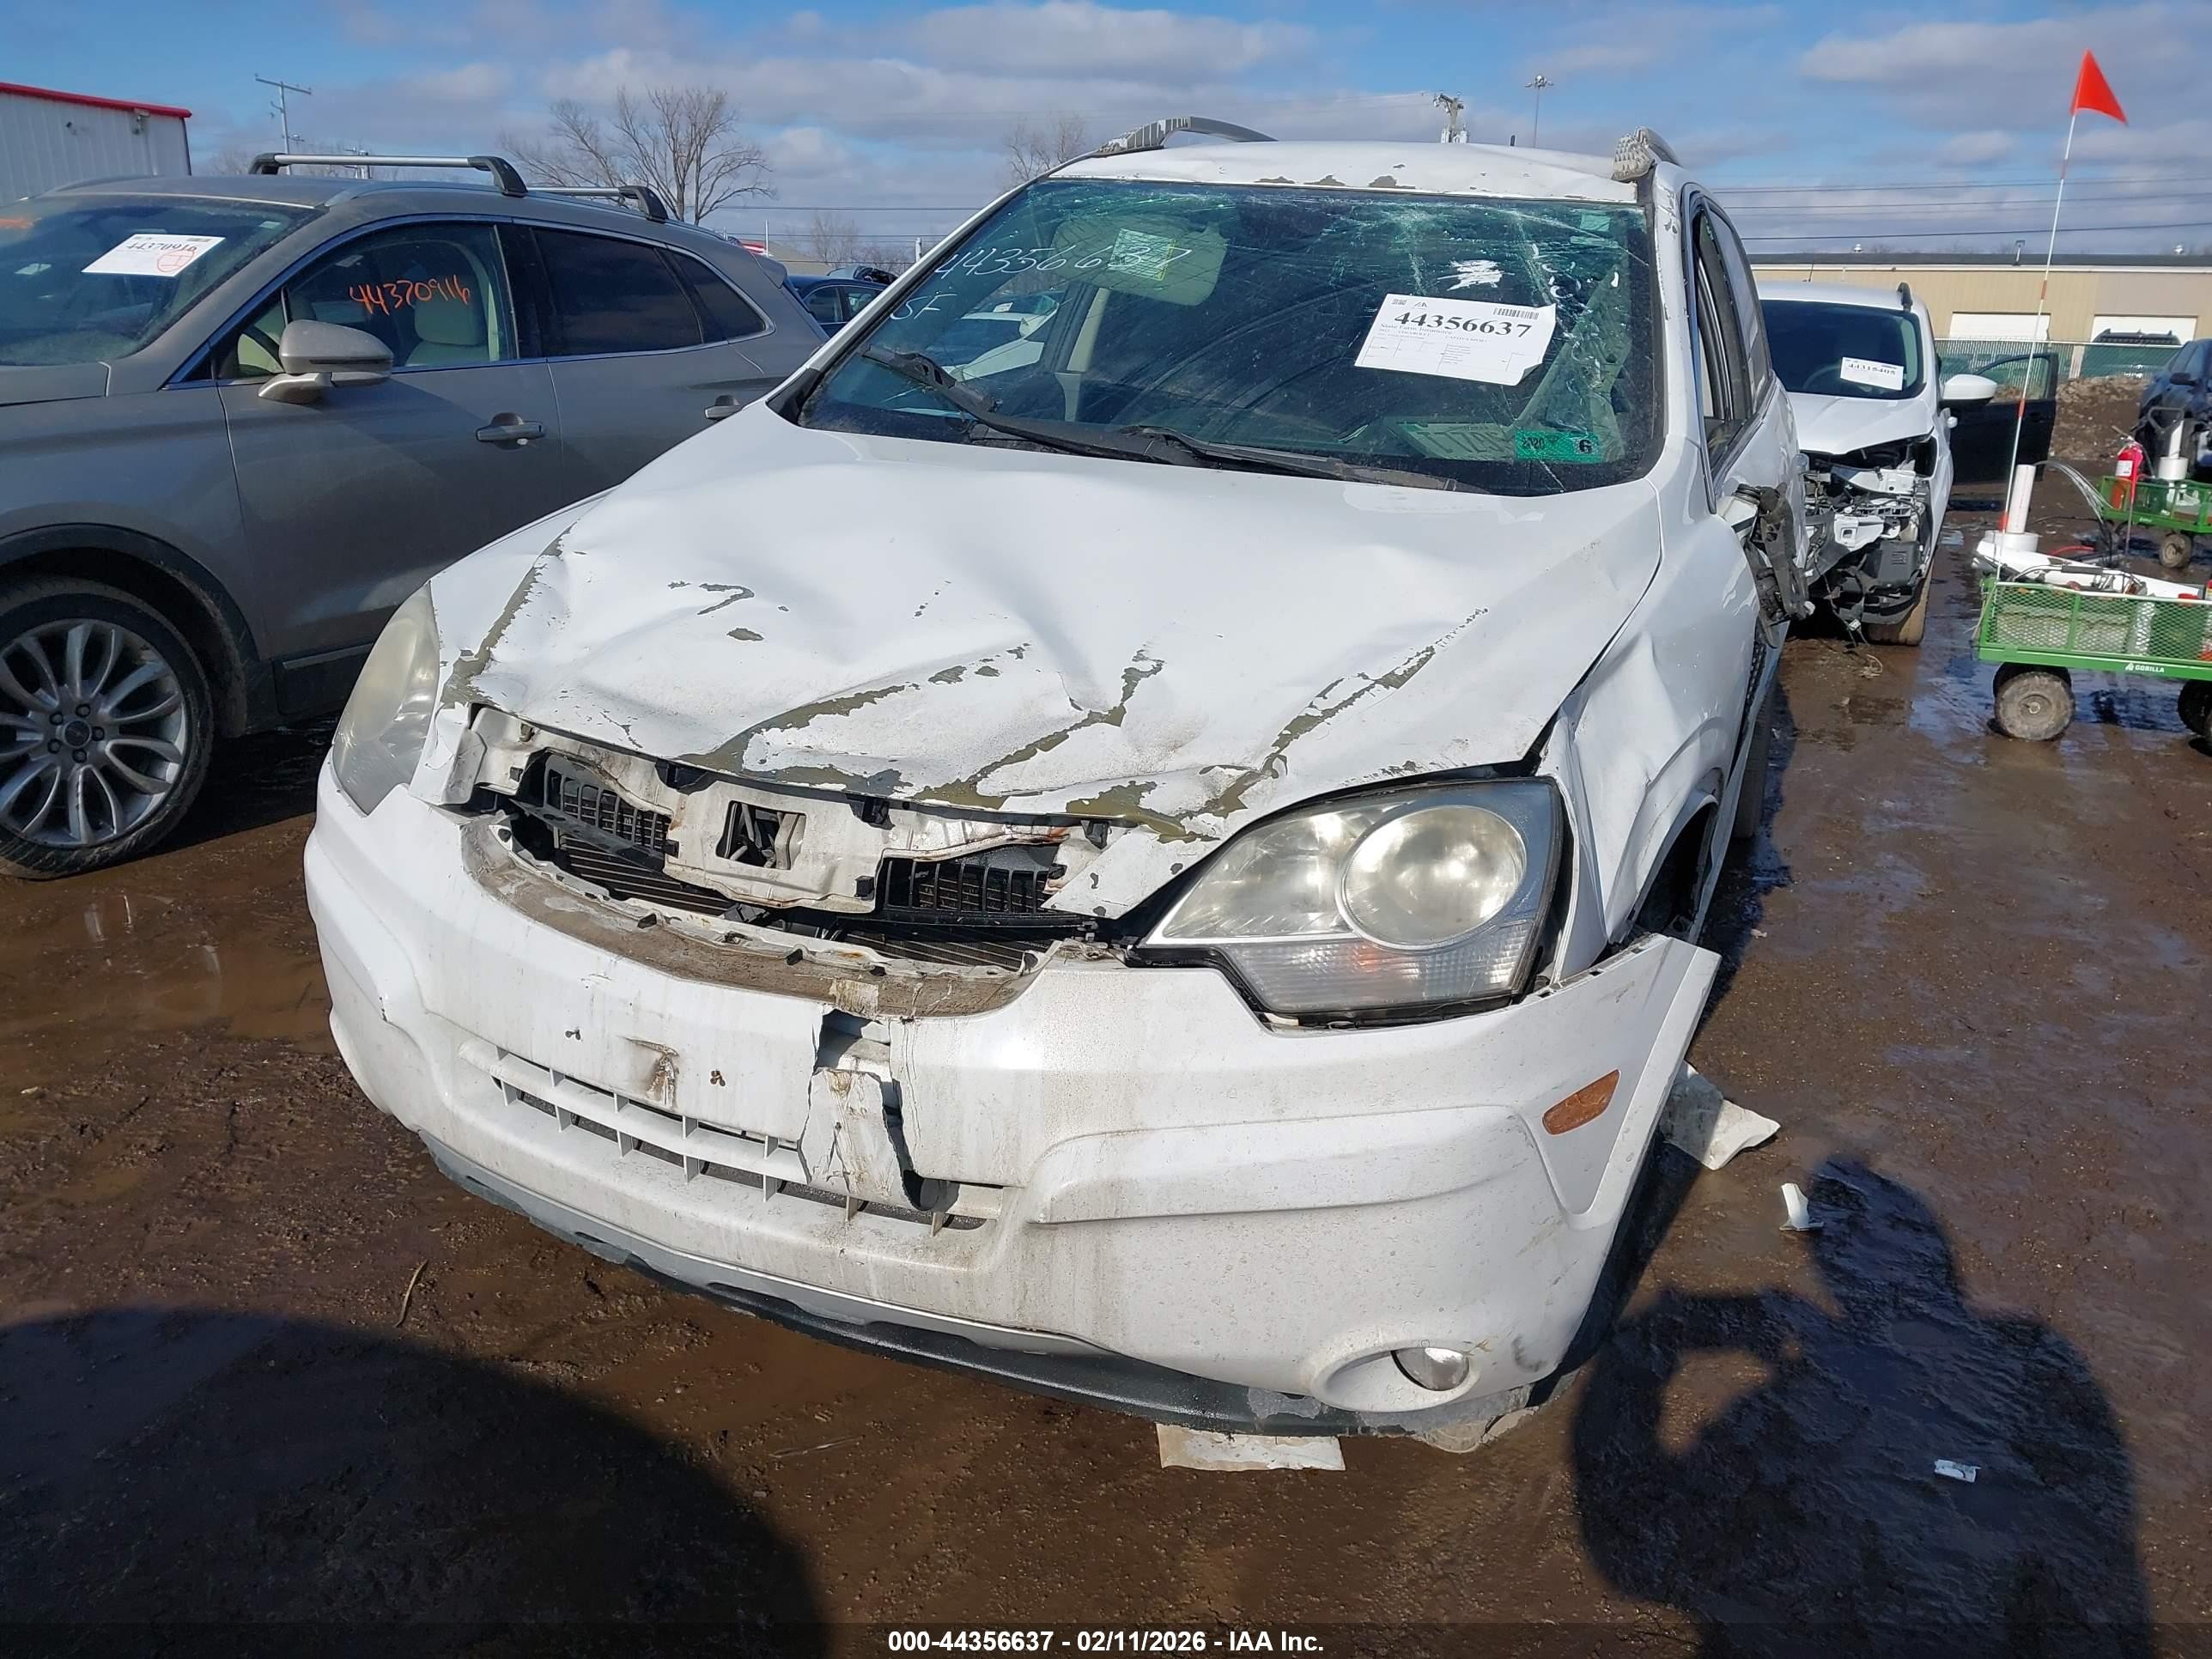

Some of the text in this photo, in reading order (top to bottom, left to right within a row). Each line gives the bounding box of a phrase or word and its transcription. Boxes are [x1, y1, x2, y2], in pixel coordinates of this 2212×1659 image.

[934, 245, 1192, 280] 44356637
[349, 274, 471, 316] 44370916
[890, 293, 957, 320] SF
[1394, 311, 1533, 338] 44356637
